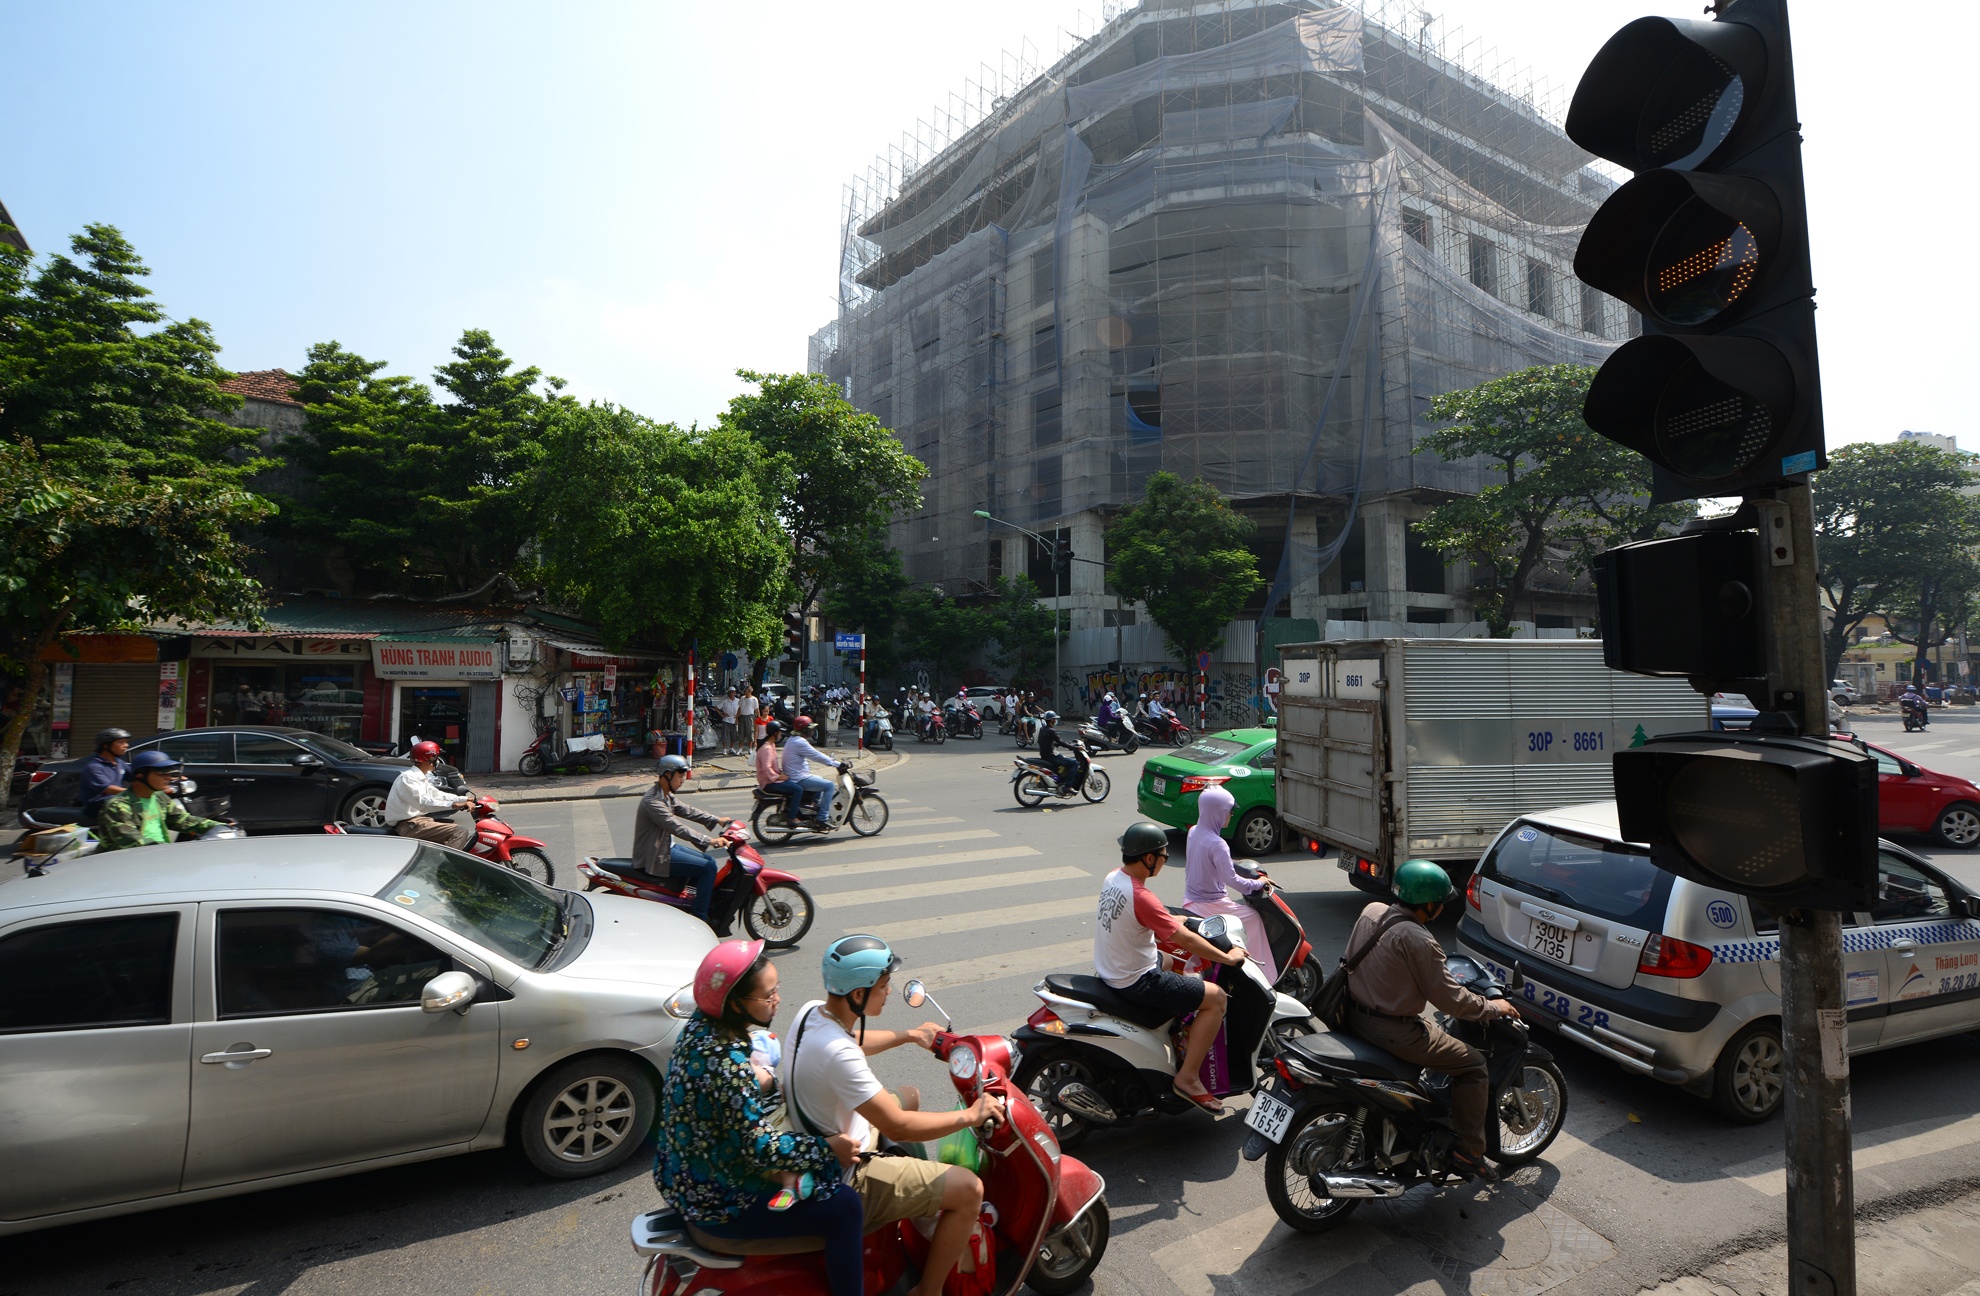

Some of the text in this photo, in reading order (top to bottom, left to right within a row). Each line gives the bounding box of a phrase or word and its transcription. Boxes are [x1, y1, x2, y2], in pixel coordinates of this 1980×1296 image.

[380, 645, 493, 667] HÙNG TRANH AUDIO
[1298, 672, 1311, 683] 30P
[1346, 675, 1363, 687] 8661
[1528, 731, 1553, 752] 30P
[1574, 731, 1604, 752] 8661
[482, 837, 498, 845] YAMAHA
[1520, 830, 1535, 841] 500
[1711, 906, 1733, 924] 500
[1533, 936, 1566, 960] 7135
[1935, 953, 1979, 971] Thăng Long
[1542, 990, 1570, 1017] 28
[1577, 1005, 1610, 1029] 28
[1209, 1063, 1217, 1090] ENJOY
[1258, 1096, 1288, 1123] 30-M8
[1252, 1111, 1282, 1138] 1654
